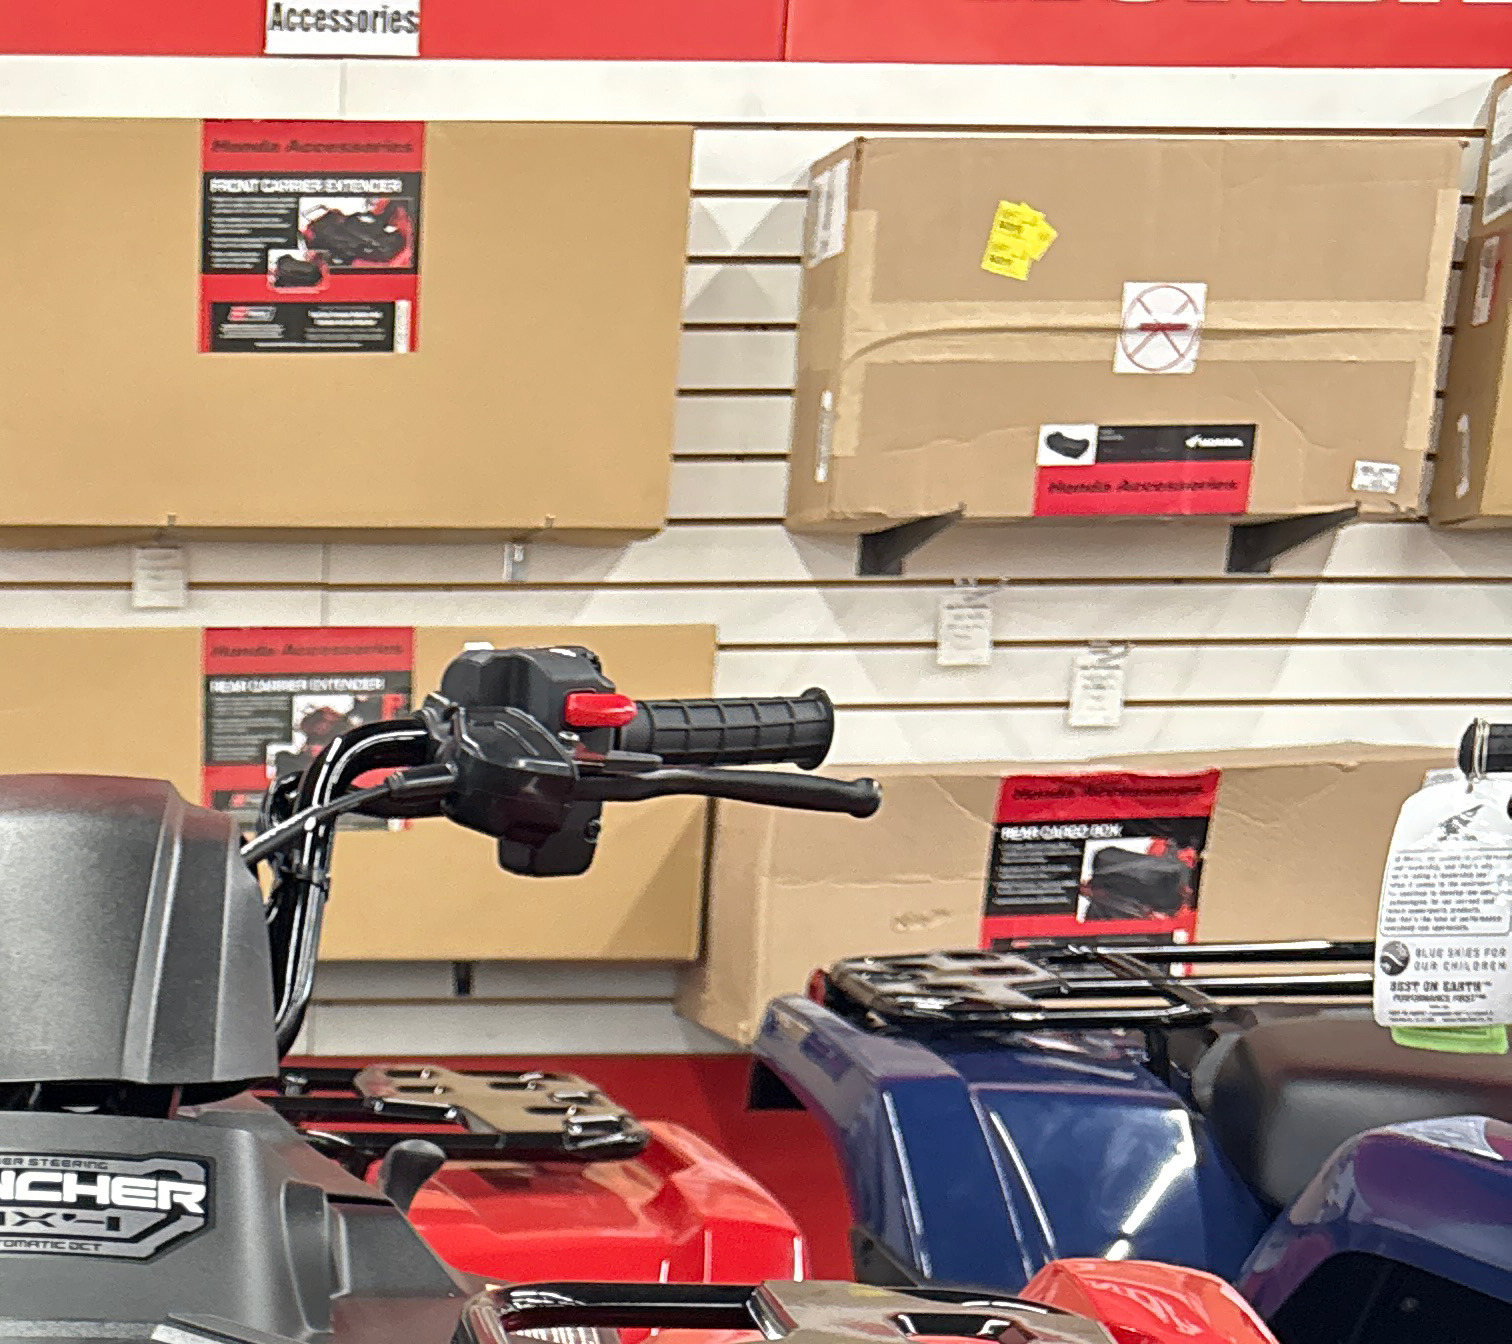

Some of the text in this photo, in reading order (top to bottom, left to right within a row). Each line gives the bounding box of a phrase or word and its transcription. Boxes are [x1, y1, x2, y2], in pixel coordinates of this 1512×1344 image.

[268, 1, 419, 34] Accessories
[212, 139, 415, 153] Honda Accessories
[209, 178, 259, 194] FRONT
[1048, 478, 1239, 493] Honda Accessories
[211, 643, 403, 657] Honda Accessories
[1415, 947, 1444, 958] BLUE
[1484, 946, 1507, 958] FOR
[1413, 960, 1507, 971] OUR CHILDREN
[1389, 981, 1421, 993] BEST
[1422, 981, 1439, 992] ON
[28, 1158, 108, 1170] STEERING
[68, 1241, 102, 1252] DCT
